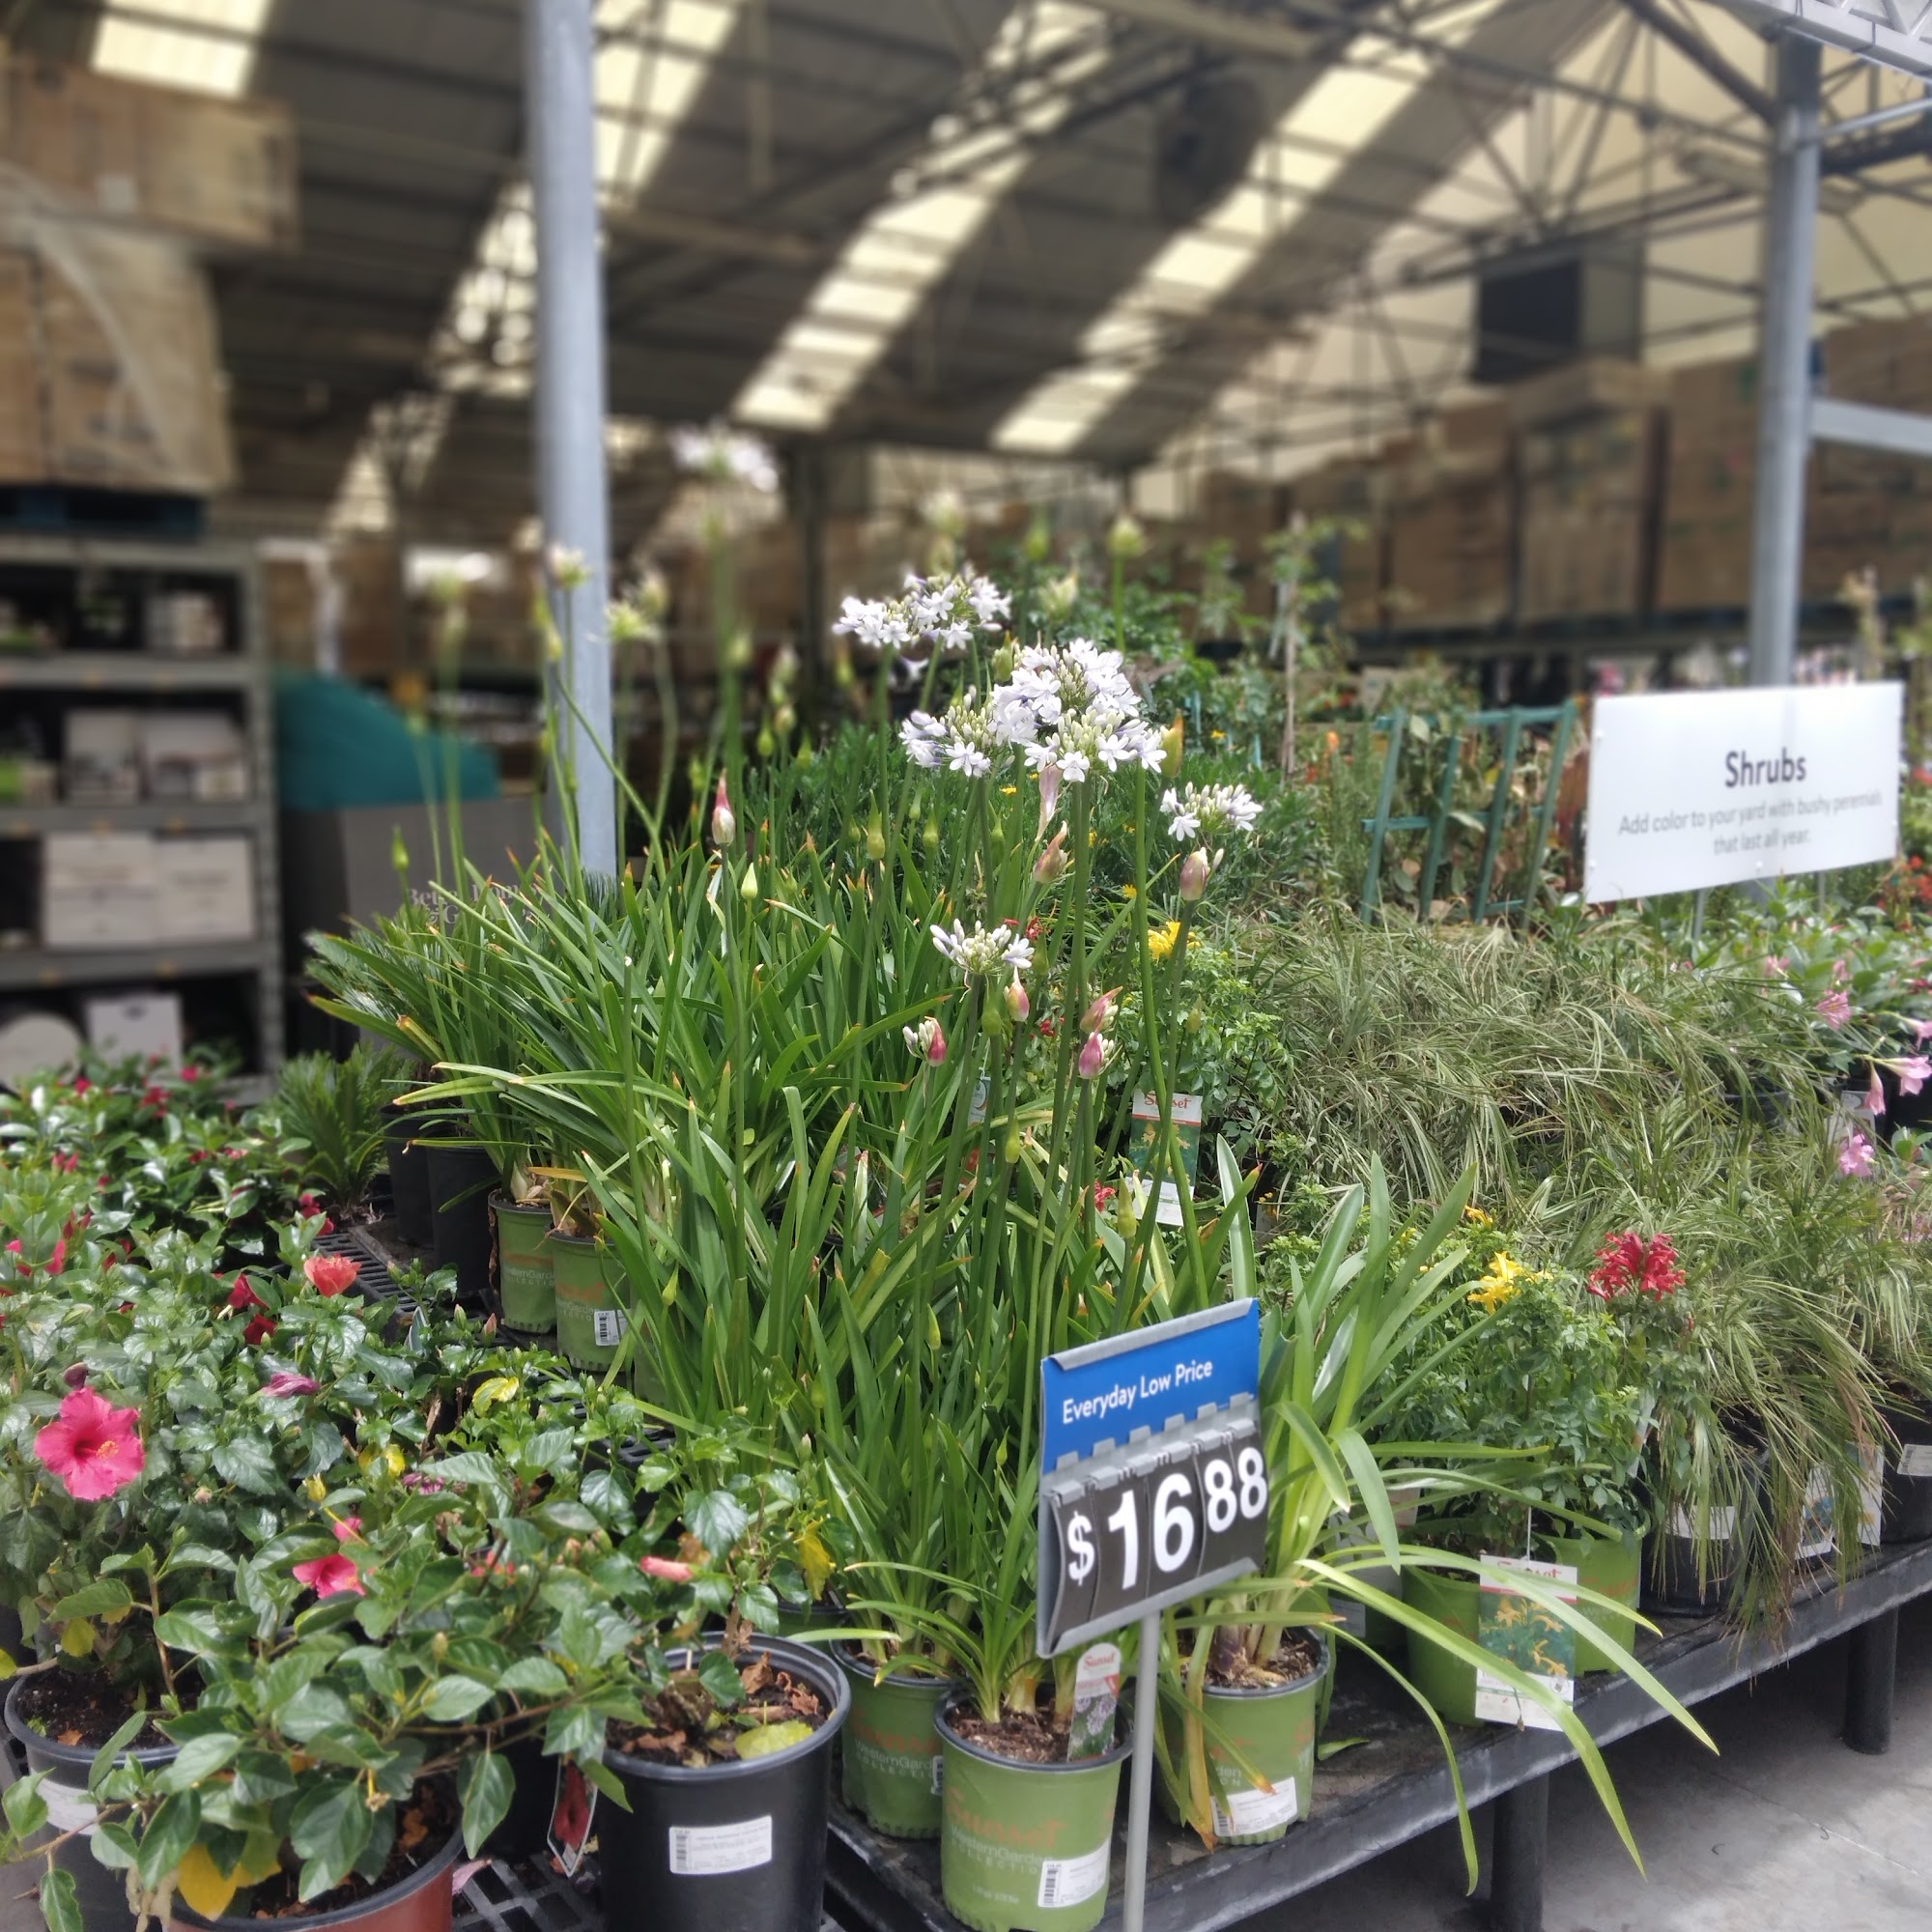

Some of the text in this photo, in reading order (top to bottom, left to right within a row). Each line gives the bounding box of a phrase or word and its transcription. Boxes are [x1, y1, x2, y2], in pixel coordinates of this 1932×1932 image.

[1724, 747, 1806, 788] Shrubs
[1618, 813, 1649, 836] Add
[1652, 810, 1688, 832] color
[1690, 810, 1706, 828] to
[1709, 807, 1737, 830] your
[1739, 801, 1767, 825] yard
[1768, 799, 1795, 819] with
[1797, 796, 1831, 816] bushy
[1713, 835, 1739, 856] that
[1741, 832, 1762, 852] last
[1764, 828, 1780, 848] all
[1145, 1093, 1192, 1110] Sset
[1063, 1360, 1213, 1425] Everyday Low Price
[855, 1739, 933, 1770] WesternGard
